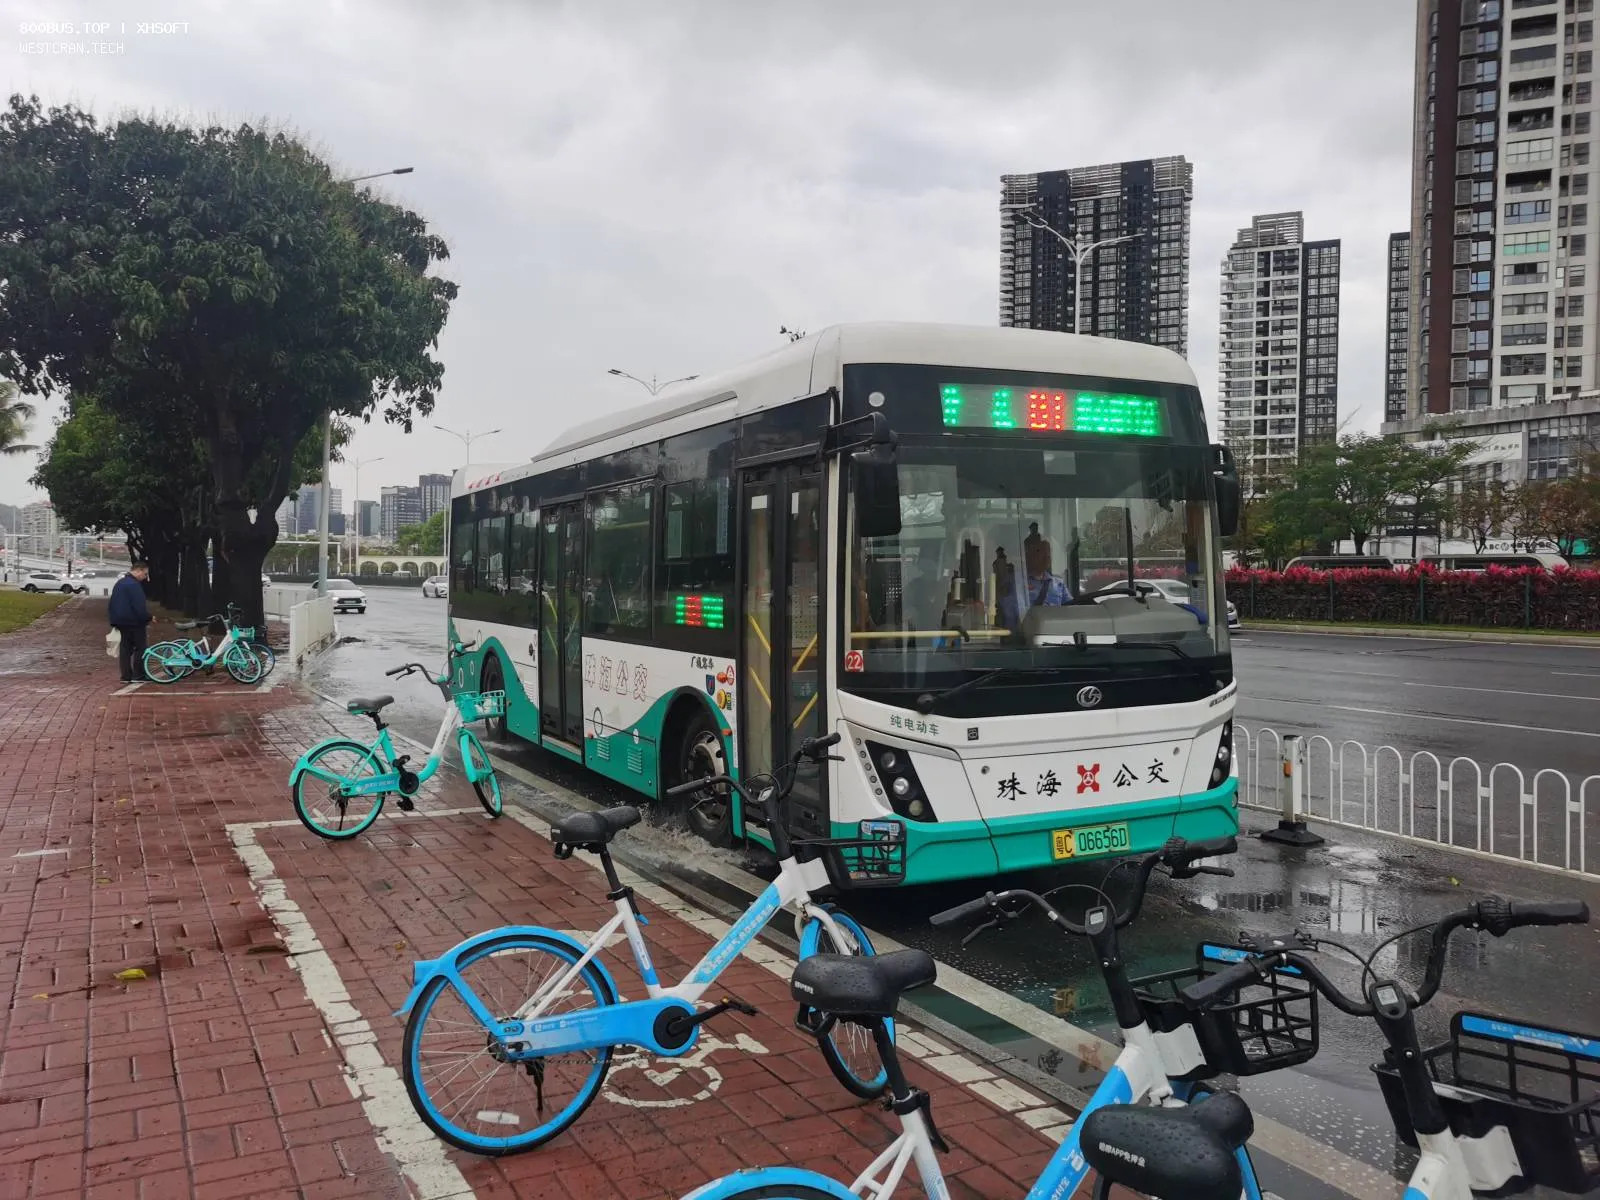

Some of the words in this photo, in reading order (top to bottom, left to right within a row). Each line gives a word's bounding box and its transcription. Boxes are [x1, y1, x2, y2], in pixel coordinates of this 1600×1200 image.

[847, 655, 862, 670] 22
[890, 714, 940, 736] 纯电动车
[997, 769, 1062, 801] 珠海
[1112, 758, 1169, 788] 公交
